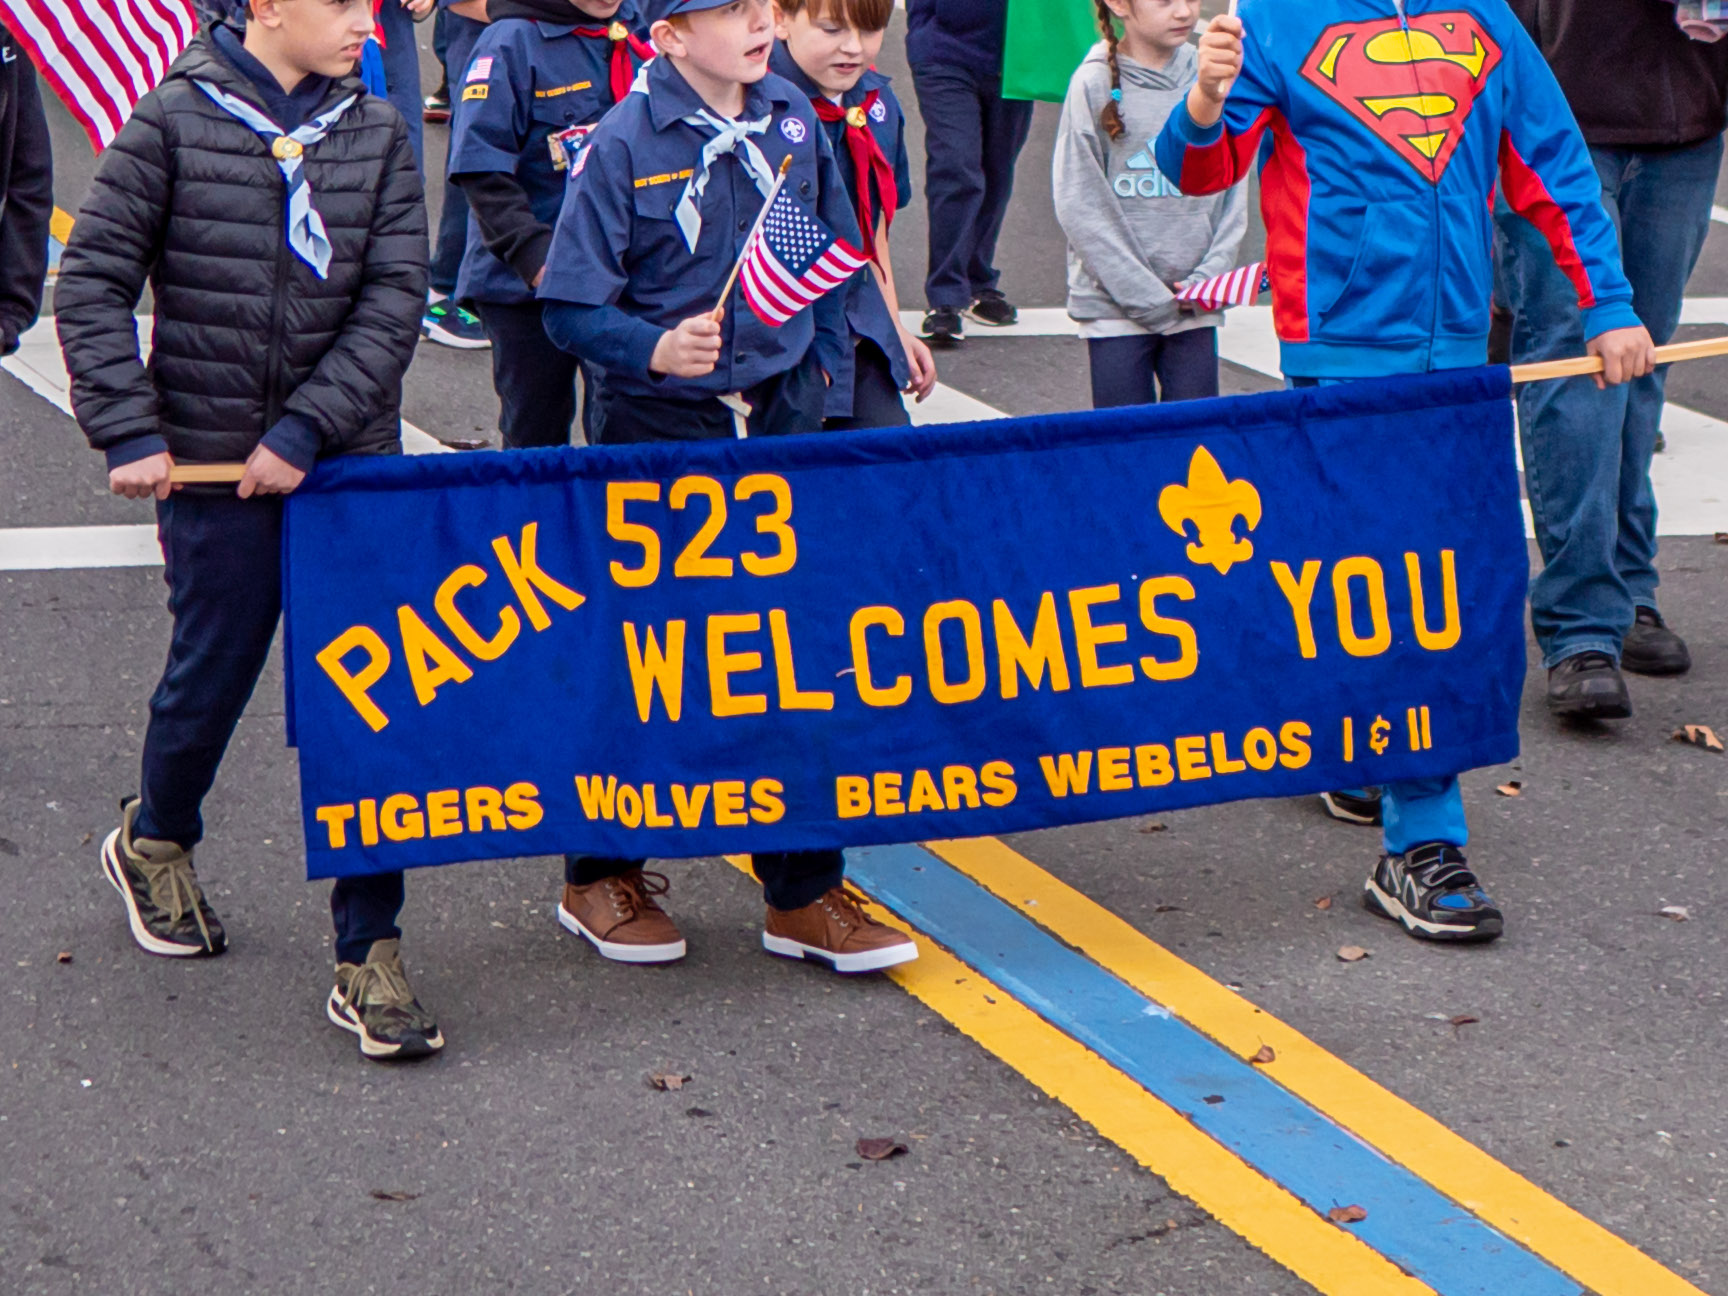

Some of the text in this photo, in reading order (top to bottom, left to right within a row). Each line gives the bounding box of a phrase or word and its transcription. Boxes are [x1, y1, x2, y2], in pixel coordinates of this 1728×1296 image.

[316, 474, 797, 732] PACK 523
[623, 550, 1461, 722] WELCOMES YOU
[316, 783, 543, 848] TIGERS
[575, 776, 785, 829] WOLVES
[836, 761, 1017, 819] BEARS
[1039, 722, 1311, 798] WEBELOS
